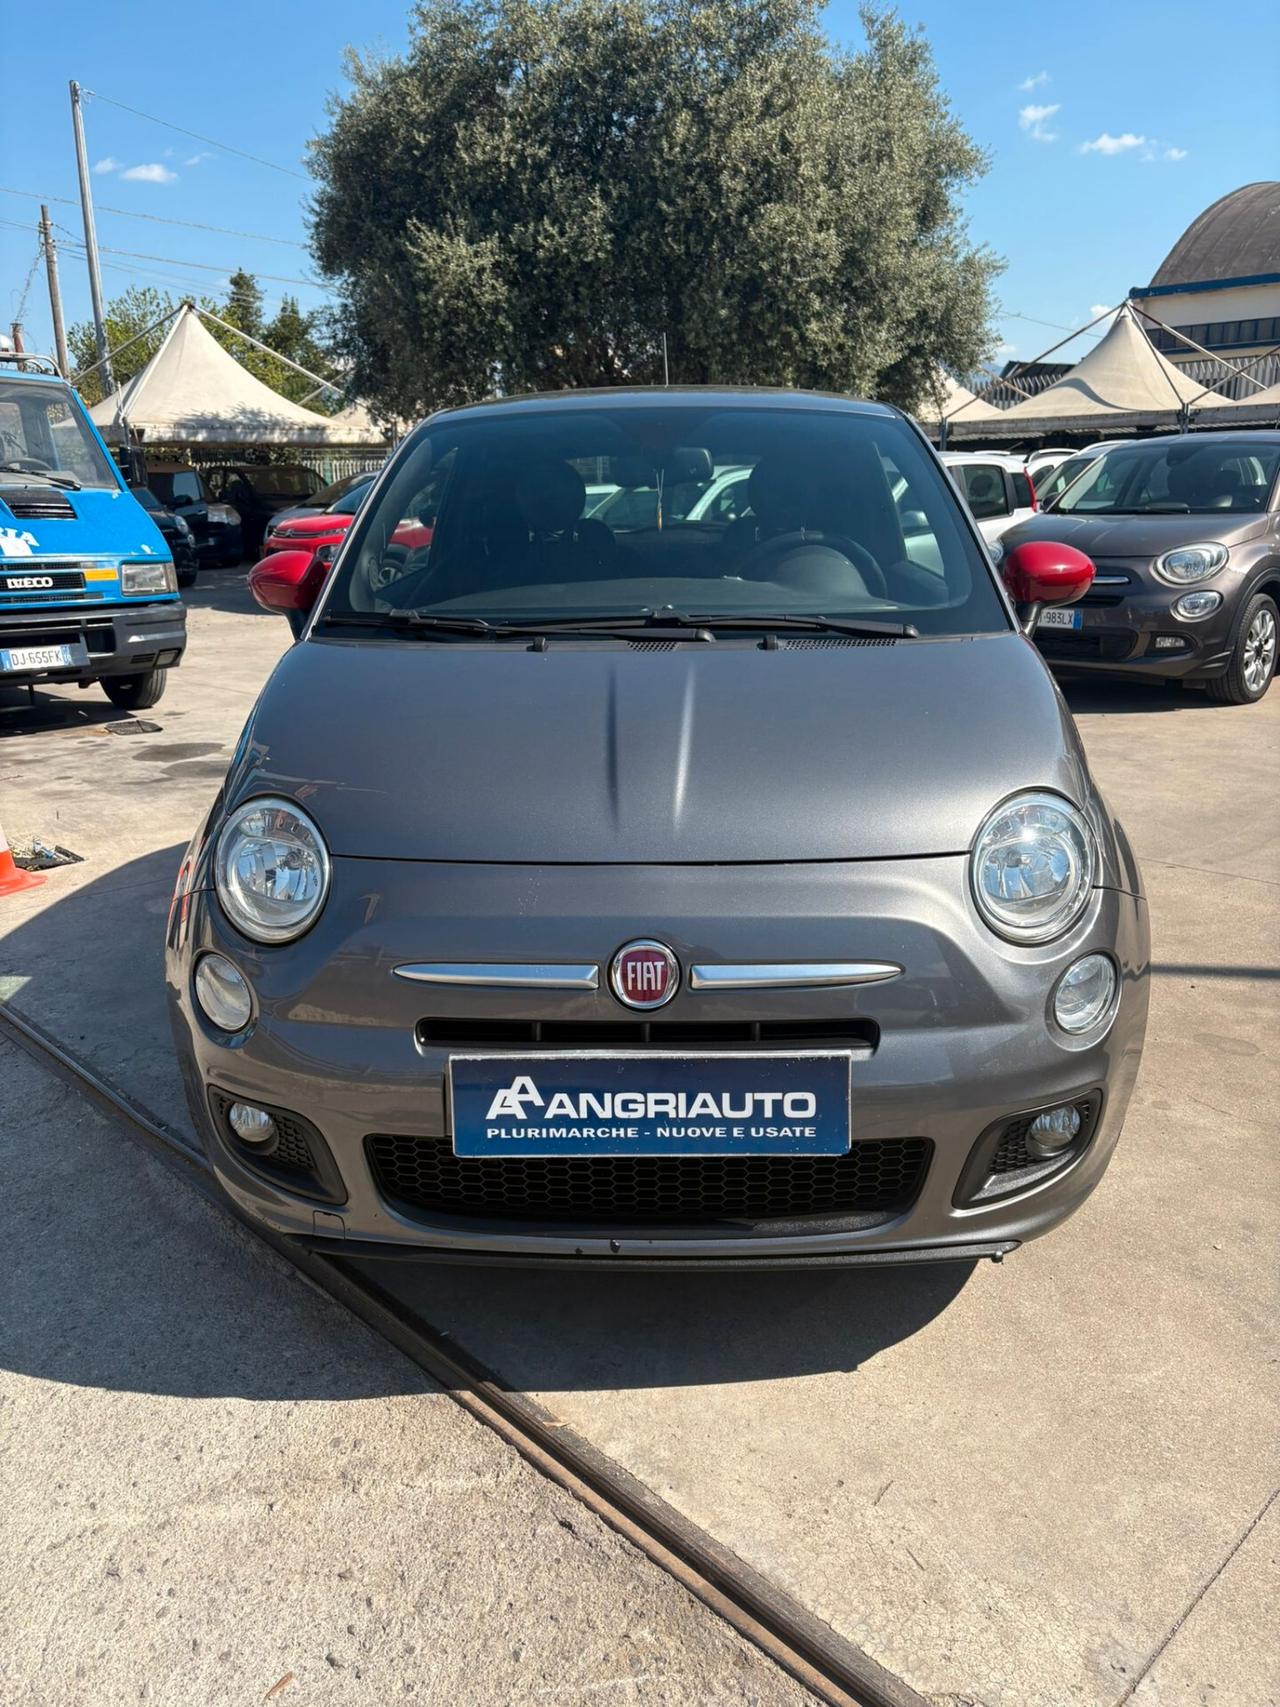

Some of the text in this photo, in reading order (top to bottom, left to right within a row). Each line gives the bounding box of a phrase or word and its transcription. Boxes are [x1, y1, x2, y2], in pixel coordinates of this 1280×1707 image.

[6, 577, 54, 589] IVECO
[627, 961, 665, 991] FIAT
[544, 1091, 817, 1119] ANGRIAUTO
[486, 1127, 639, 1139] PLURIMARCHE
[656, 1126, 728, 1138] NUOVE
[732, 1126, 745, 1138] E
[750, 1126, 817, 1138] USATE
